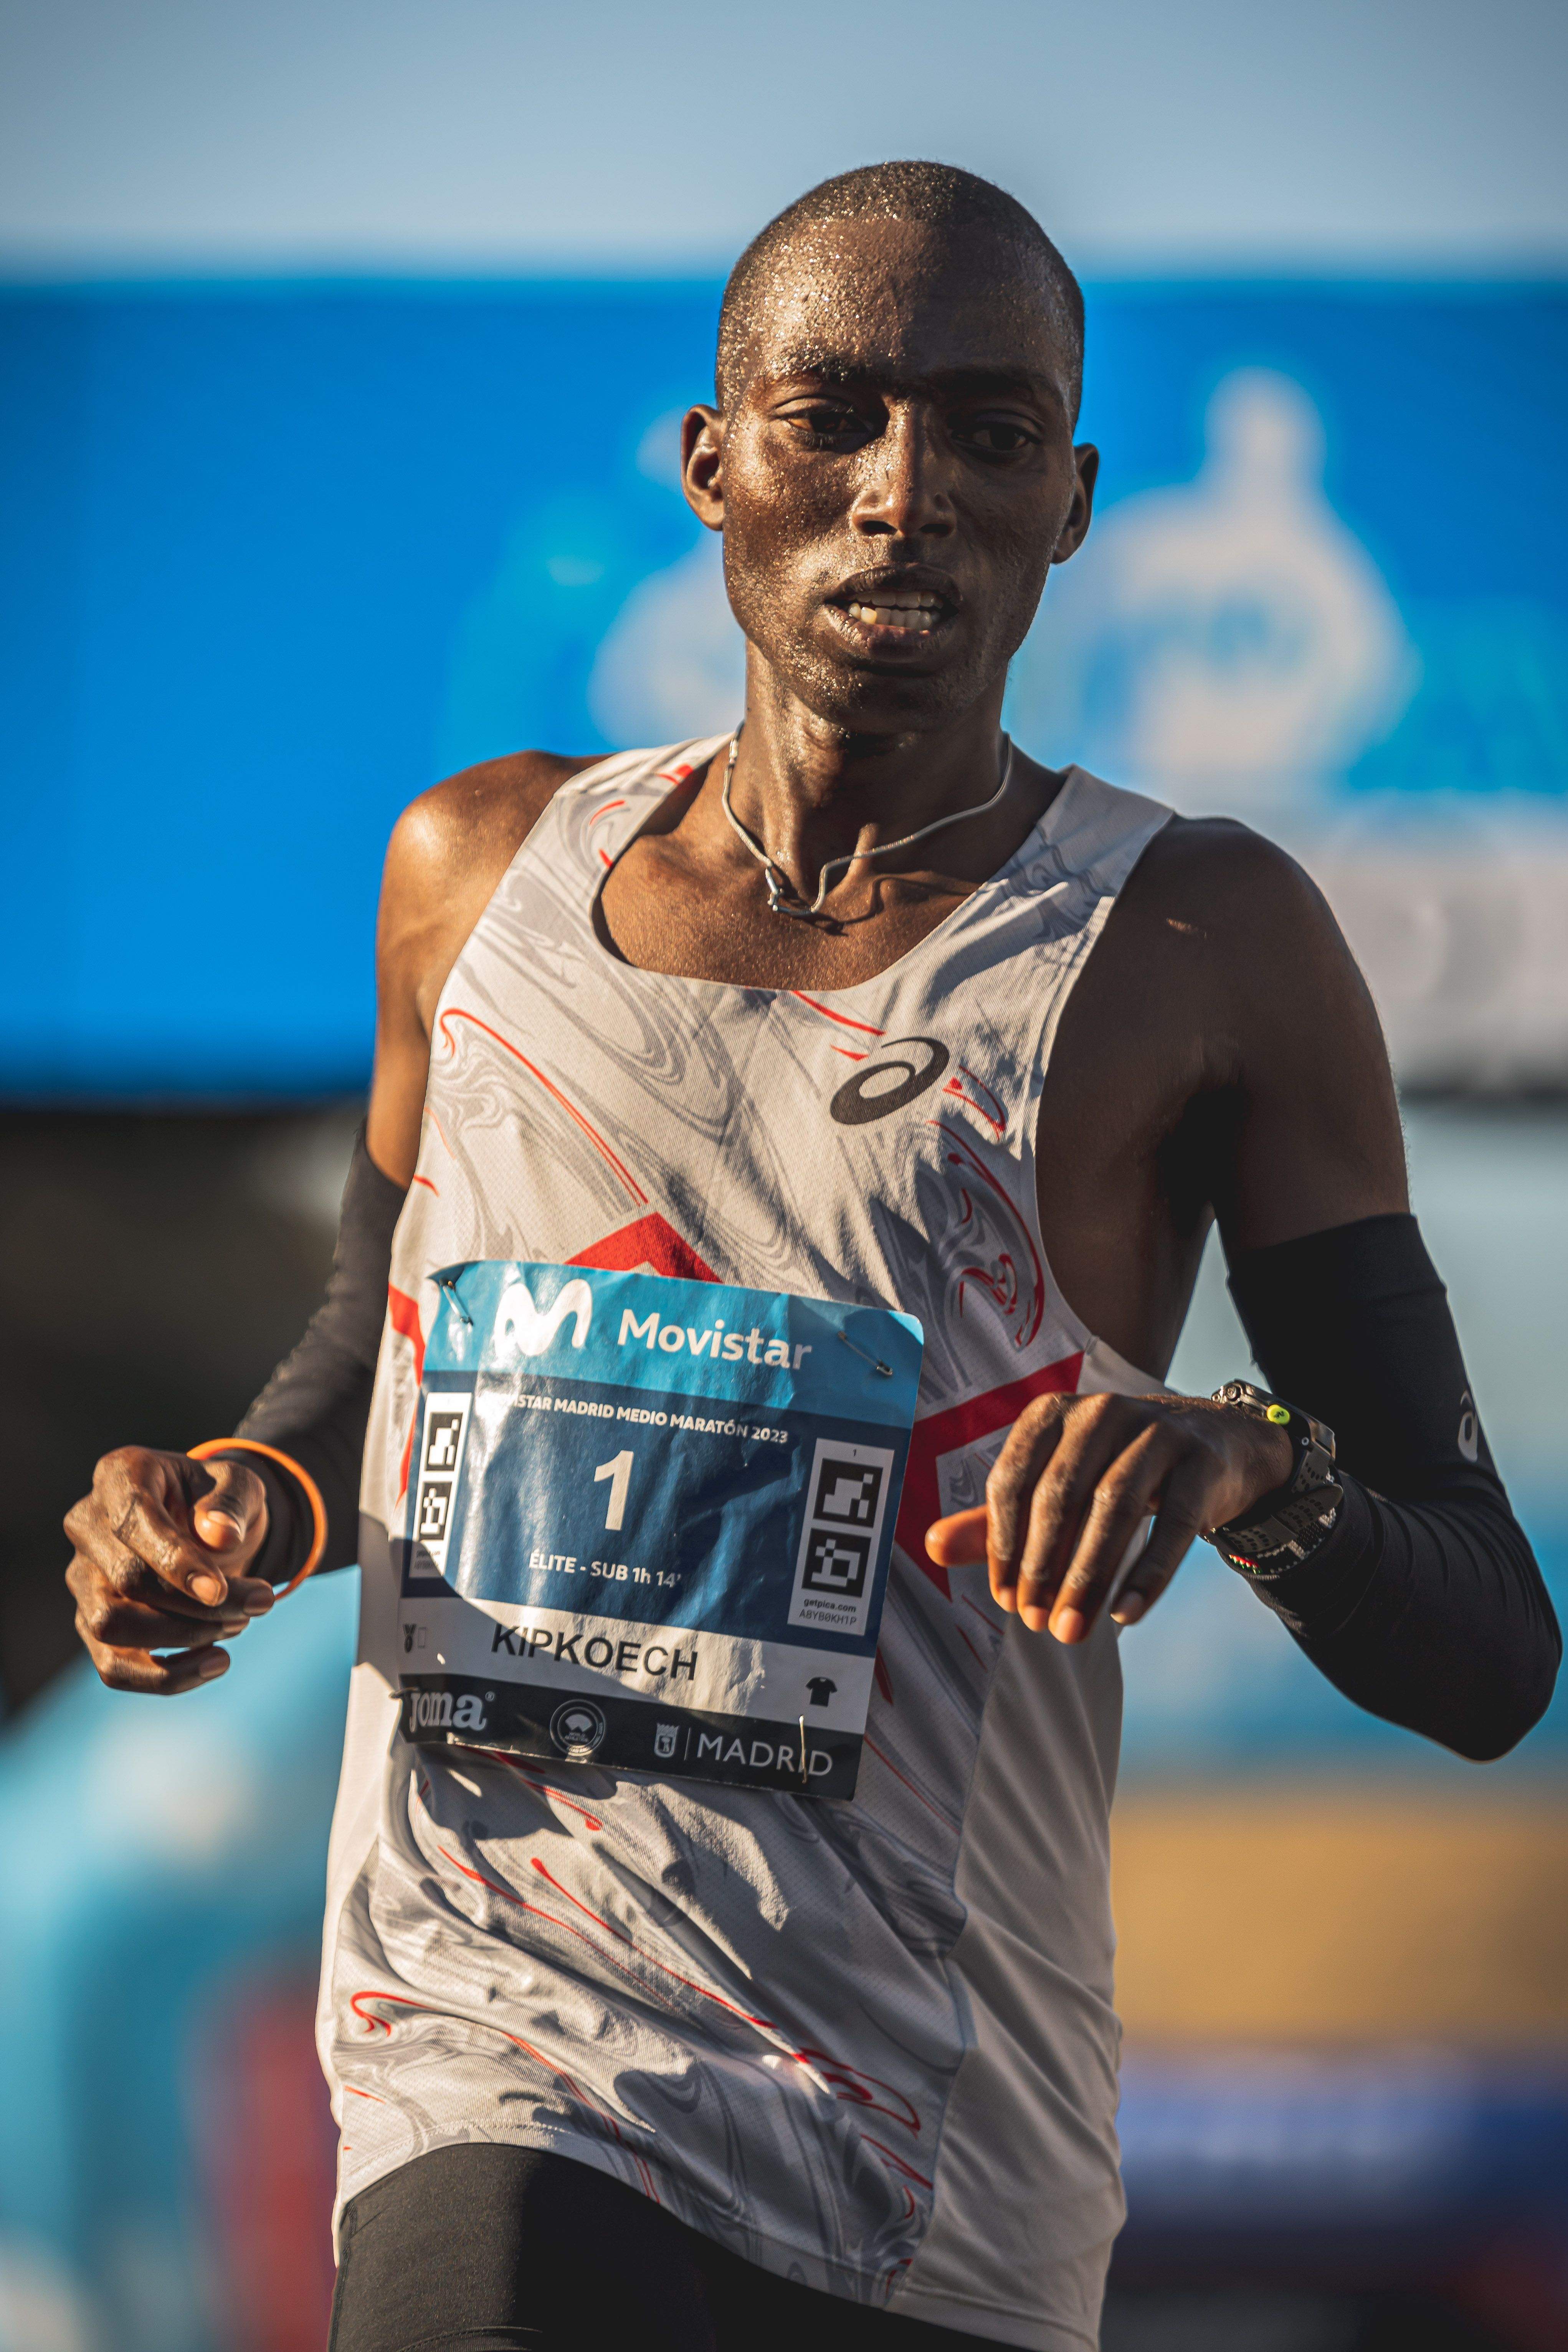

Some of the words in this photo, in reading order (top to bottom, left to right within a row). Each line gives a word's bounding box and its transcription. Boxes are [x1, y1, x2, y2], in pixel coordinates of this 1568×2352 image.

[617, 1308, 812, 1369] Movistar
[554, 1398, 614, 1418] MADRID
[616, 1406, 668, 1426] MEDIO
[669, 1414, 748, 1438] MARATÓN
[750, 1425, 789, 1444] 2023
[594, 1450, 634, 1531] 1
[528, 1548, 577, 1574] ÉLITE
[590, 1561, 629, 1581] SUB
[632, 1567, 651, 1585] 1h
[491, 1622, 698, 1681] KIPKOECH
[696, 1733, 833, 1776] MADRID
